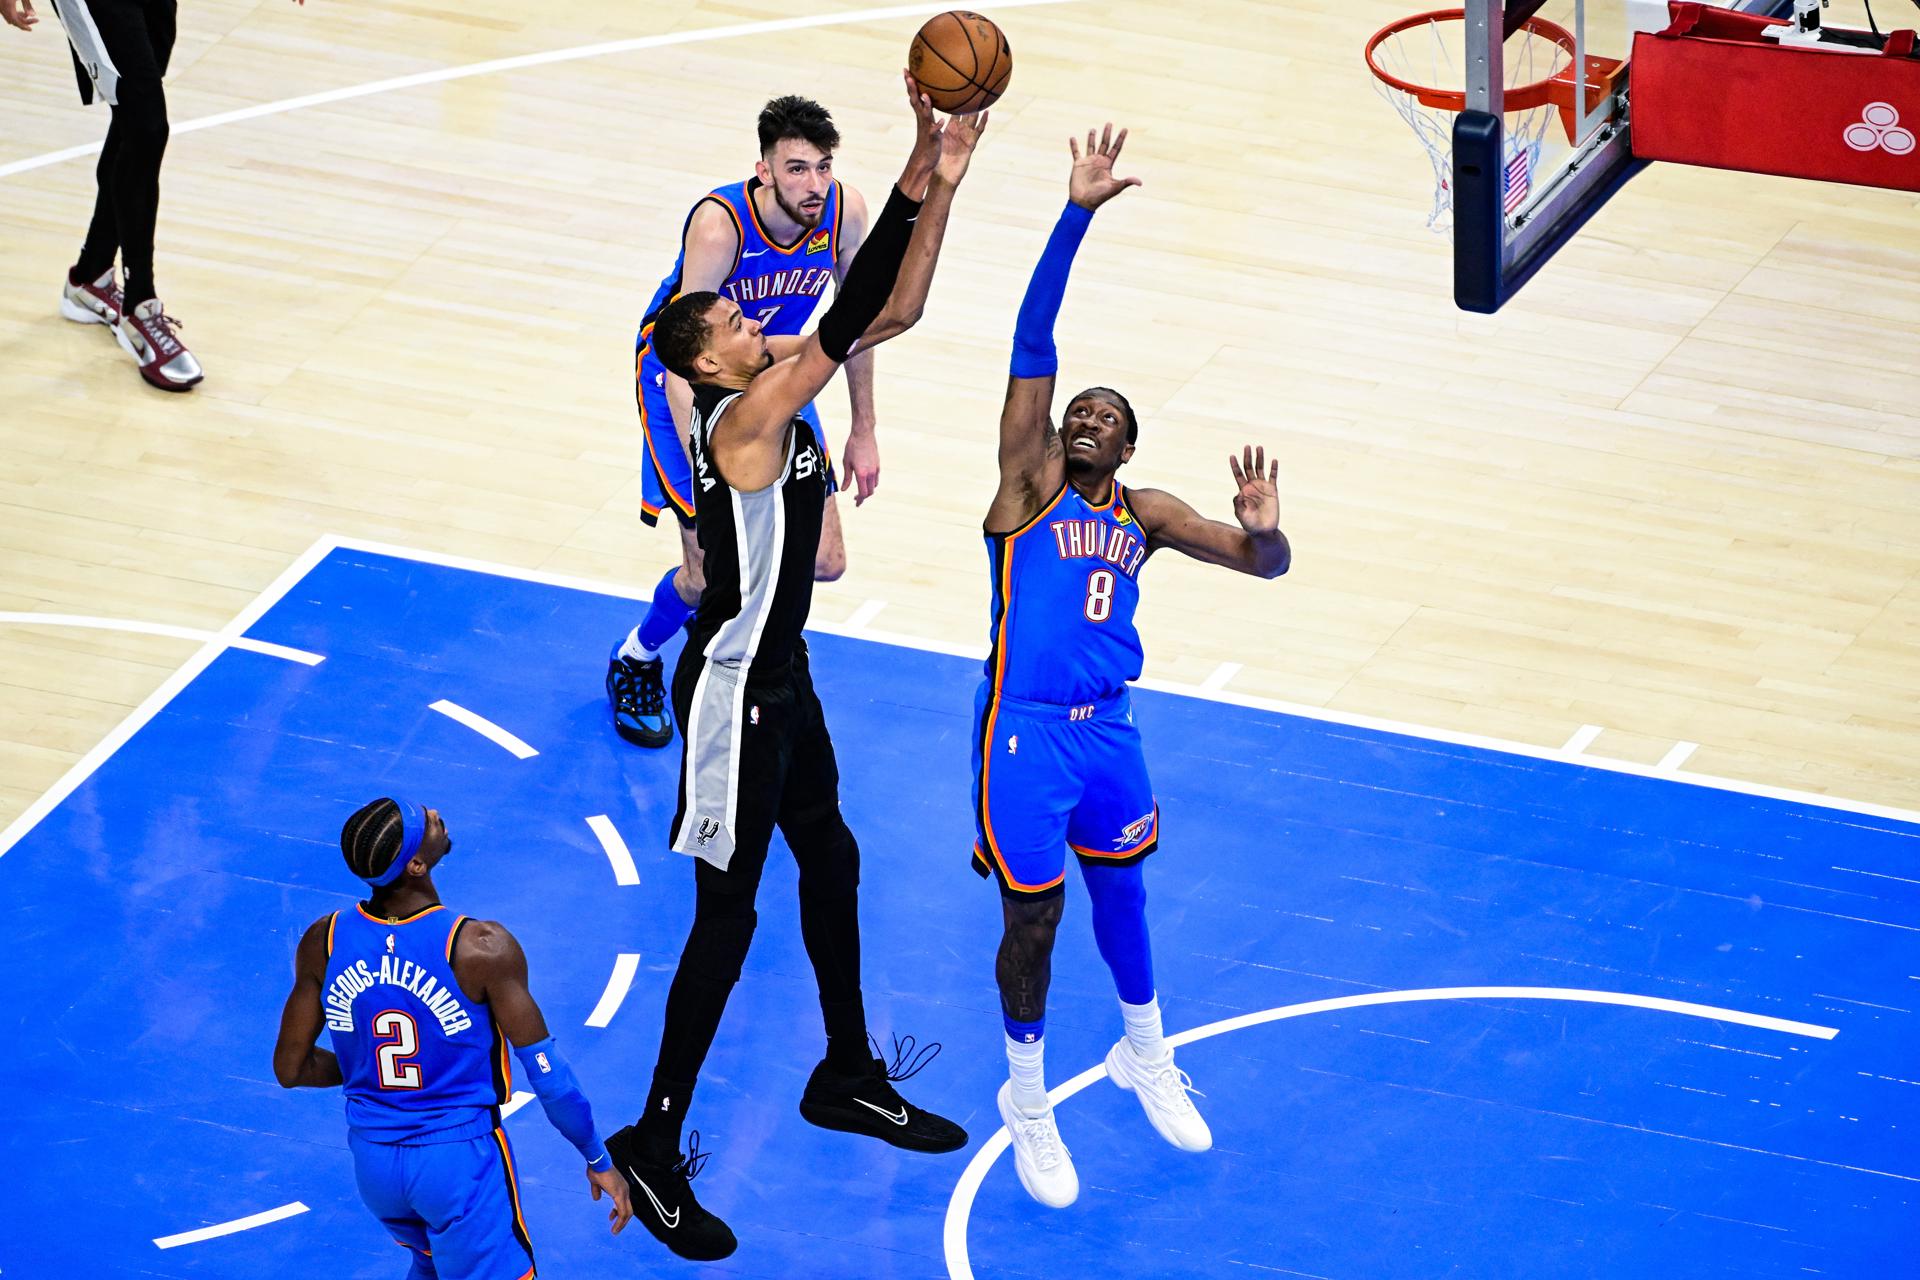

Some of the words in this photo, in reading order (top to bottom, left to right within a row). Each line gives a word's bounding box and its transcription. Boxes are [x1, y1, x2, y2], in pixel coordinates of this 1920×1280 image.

[726, 268, 832, 302] THUNDER
[757, 304, 784, 329] 7
[1050, 519, 1146, 577] THUNDER
[1084, 568, 1116, 623] 8
[1069, 704, 1095, 721] OKC
[325, 955, 472, 1037] GILGEOUS-ALEXANDER
[372, 1009, 423, 1090] 2
